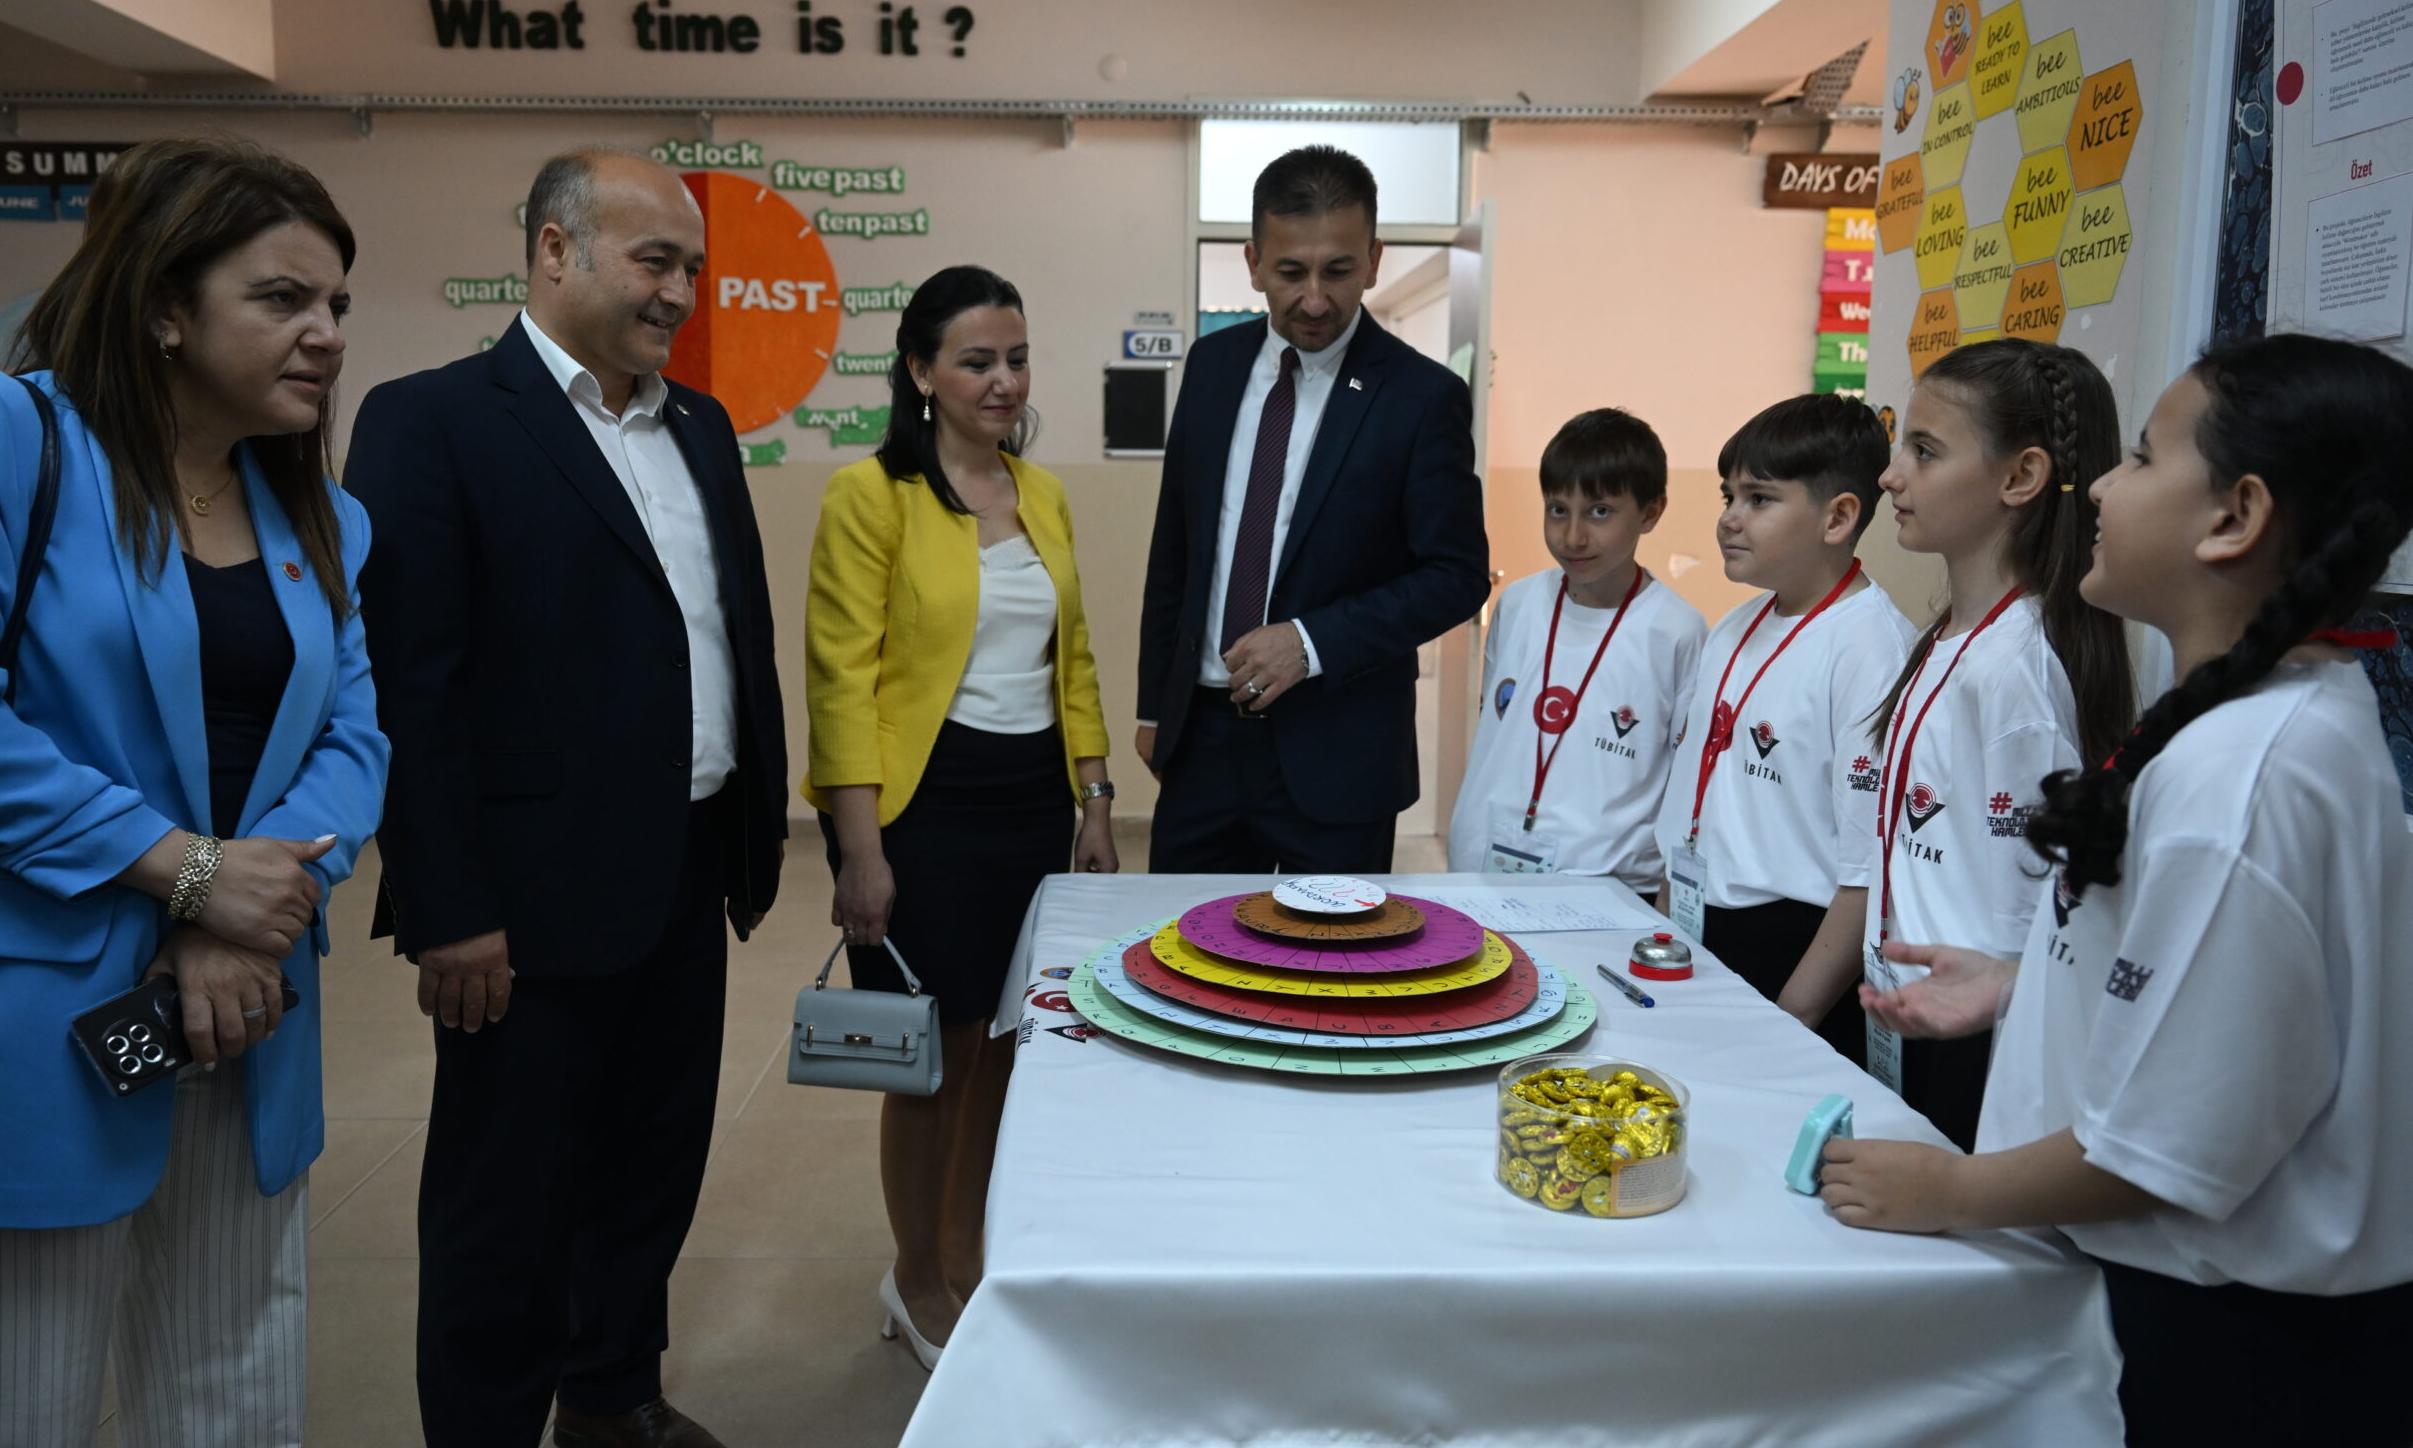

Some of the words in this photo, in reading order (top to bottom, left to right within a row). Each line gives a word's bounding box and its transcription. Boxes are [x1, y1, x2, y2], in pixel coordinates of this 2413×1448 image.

[430, 0, 585, 49] What
[632, 0, 760, 53] time
[797, 0, 844, 54] is
[879, 2, 919, 56] it
[1987, 21, 2013, 49] bee
[1975, 48, 2005, 75] READY
[2006, 40, 2020, 57] TO
[2036, 50, 2068, 80] bee
[1981, 69, 2012, 95] LEARN
[2015, 76, 2081, 116] AMBITIOUS
[2092, 81, 2127, 111] bee
[1938, 99, 1962, 126] bee
[1922, 139, 1934, 156] IN
[1934, 121, 1975, 149] CONTROL
[2080, 107, 2134, 152] NICE
[1780, 162, 1843, 192] DAYS
[1844, 166, 1879, 193] OF
[1891, 167, 1913, 192] bee
[2027, 167, 2059, 193] bee
[2351, 160, 2373, 180] Özet
[1875, 188, 1924, 221] GRATEFUL
[1931, 202, 1955, 226] bee
[2013, 188, 2071, 230] FUNNY
[2081, 204, 2114, 233] bee
[1916, 226, 1965, 259] LOVING
[1973, 238, 2000, 262] bee
[2059, 233, 2130, 268] CREATIVE
[1954, 263, 2014, 290] RESPECTFUL
[2020, 278, 2050, 304] bee
[718, 277, 826, 313] PAST
[1925, 303, 1948, 324] bee
[2005, 304, 2060, 334] CARING
[1134, 336, 1173, 354] 5/B
[1909, 329, 1960, 355] HELPFUL
